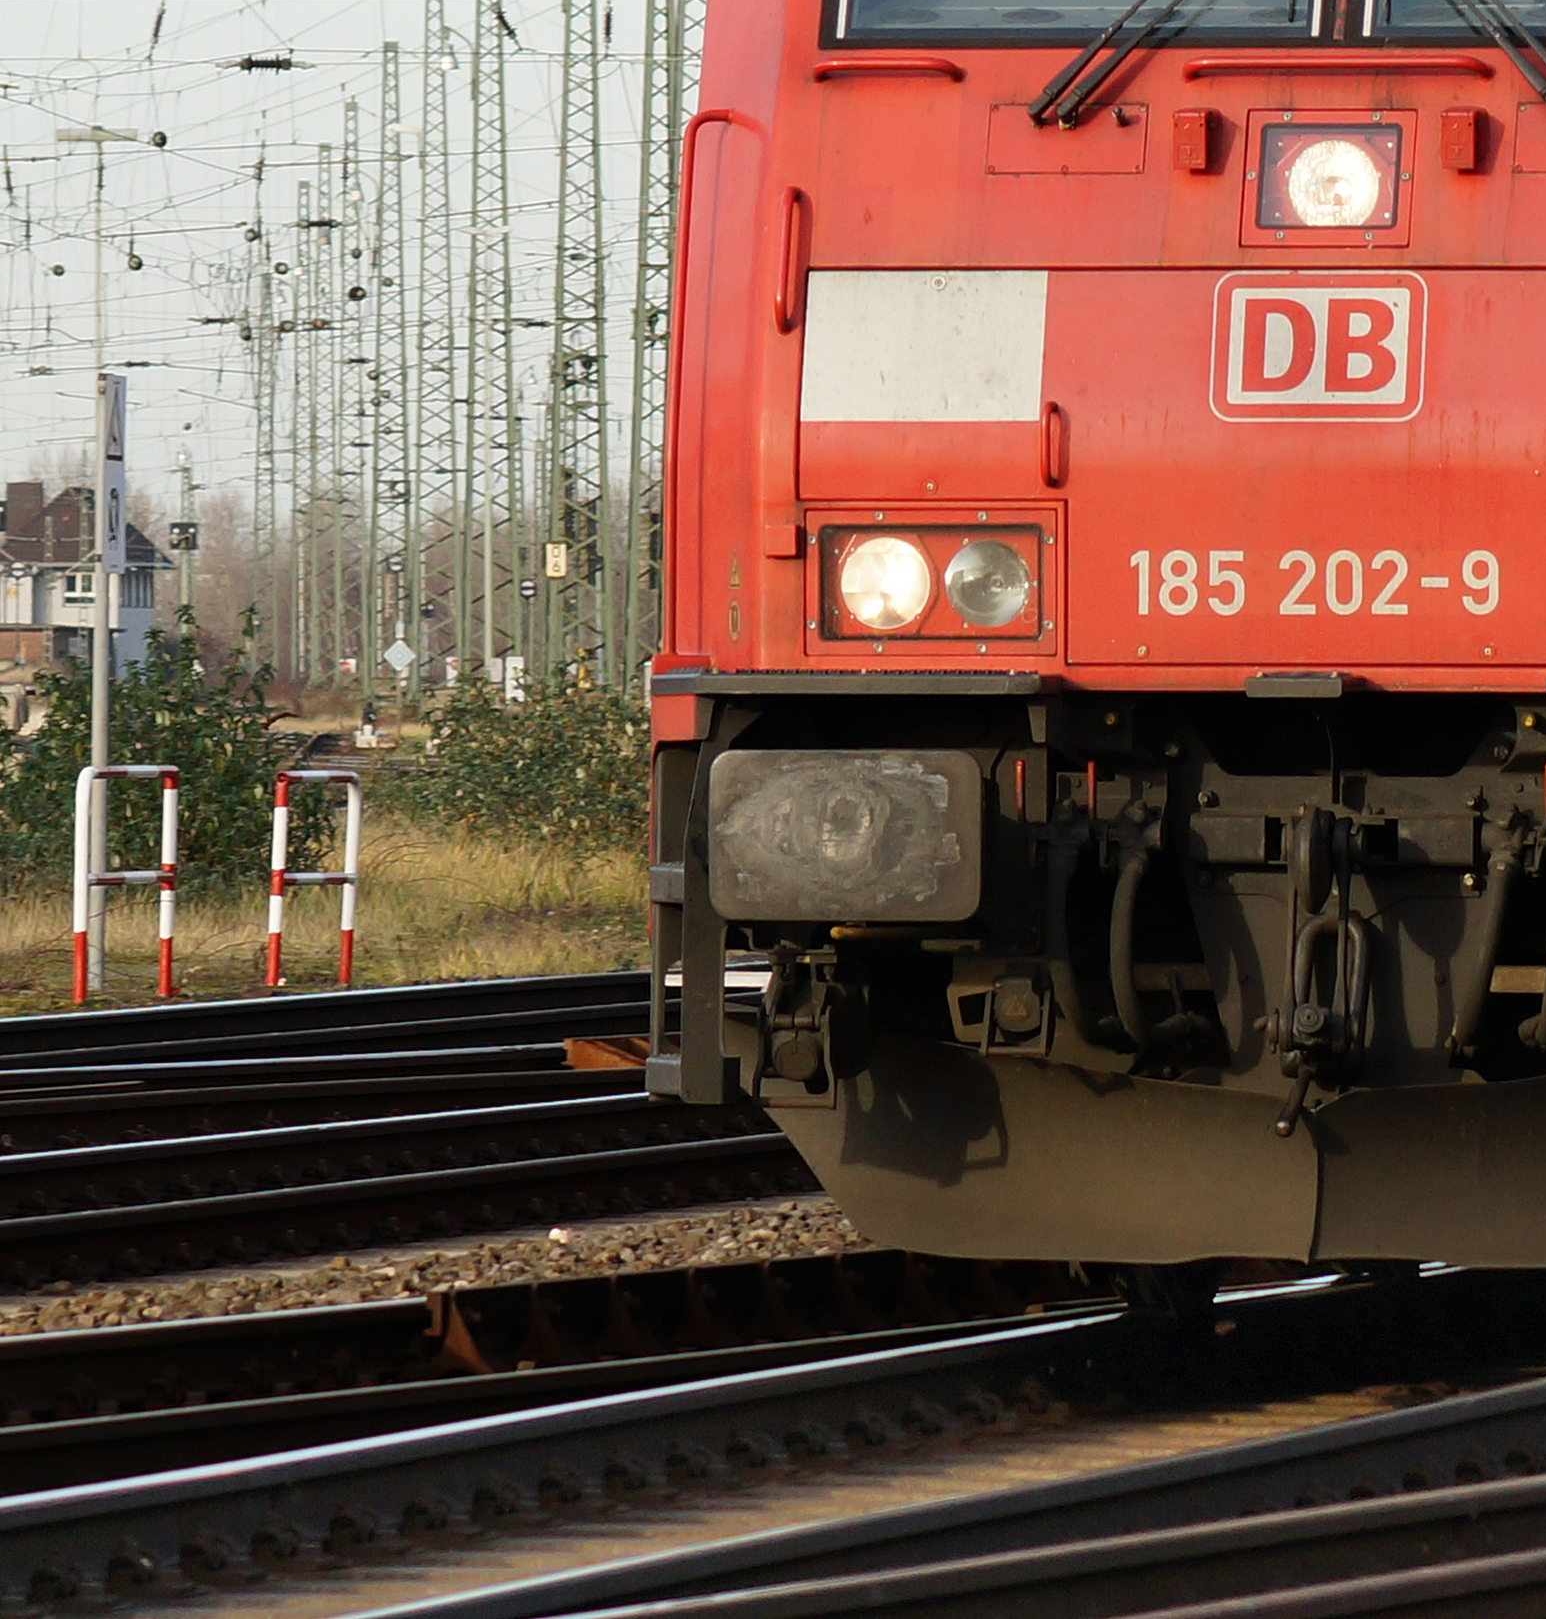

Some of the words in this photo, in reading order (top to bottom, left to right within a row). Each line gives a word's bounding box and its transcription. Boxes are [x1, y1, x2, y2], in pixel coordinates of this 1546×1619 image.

[1240, 297, 1397, 393] DB
[1129, 549, 1246, 617] 185
[1278, 549, 1500, 617] 202-9
